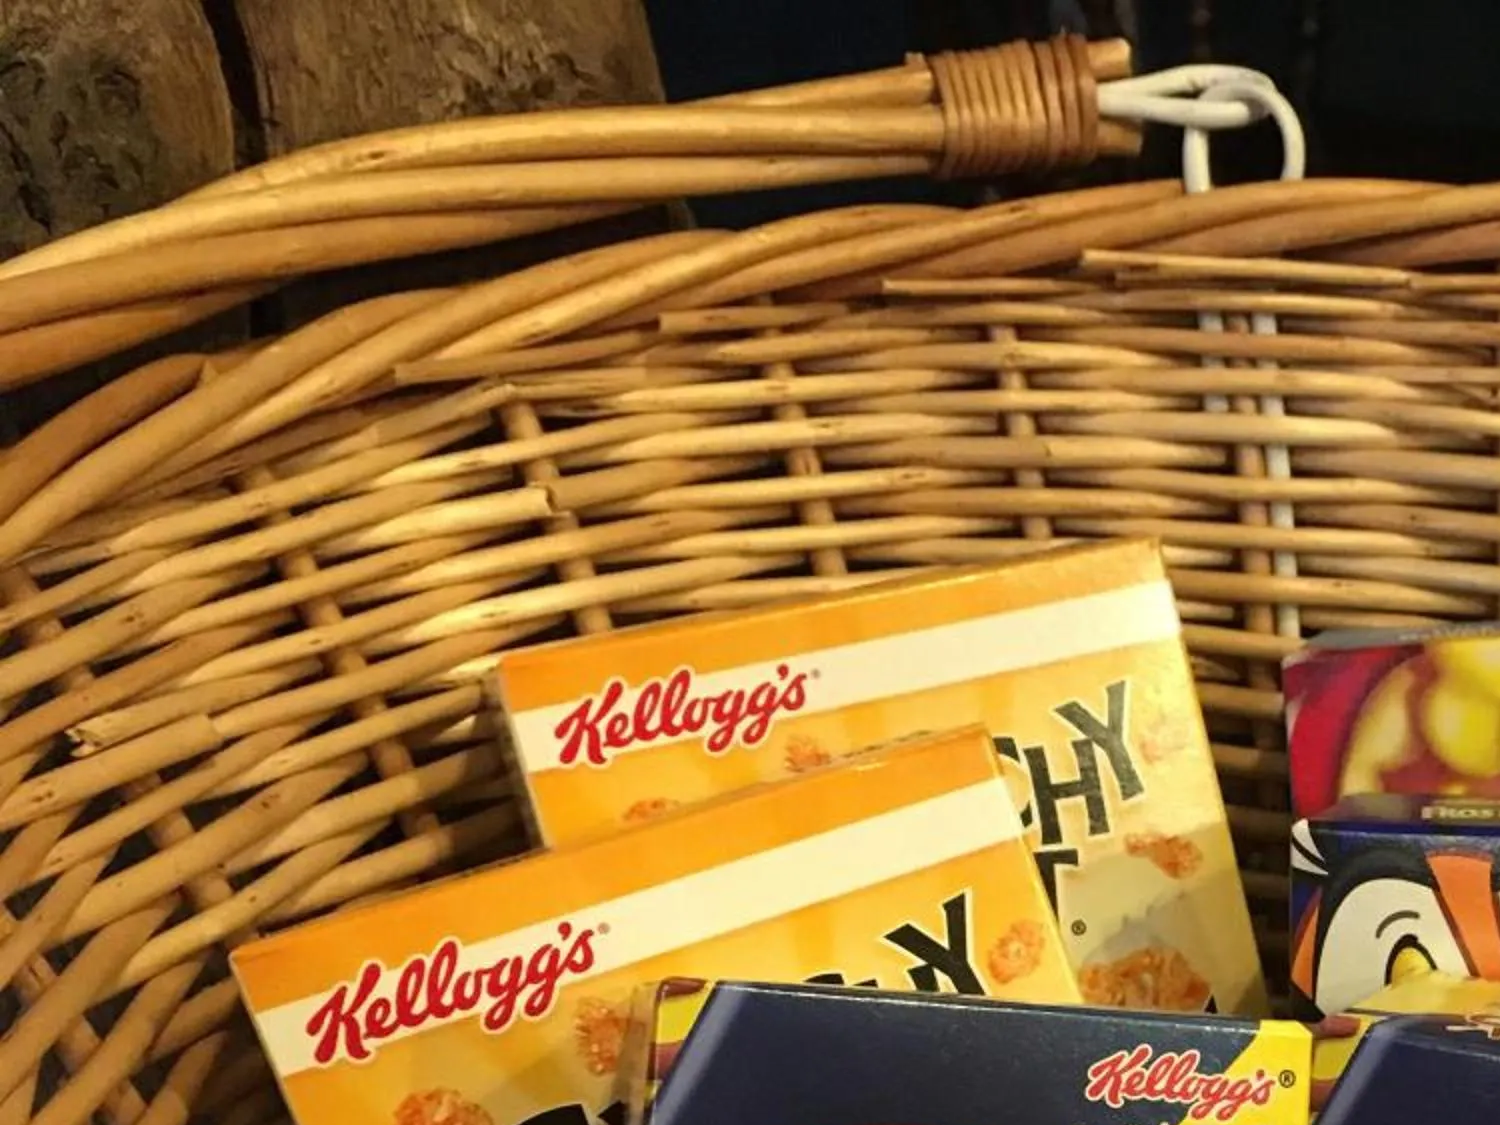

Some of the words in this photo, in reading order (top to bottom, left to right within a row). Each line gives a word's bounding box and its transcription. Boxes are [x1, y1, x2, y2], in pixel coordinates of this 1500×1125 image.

[554, 663, 808, 767] Kellogg's
[305, 920, 598, 1064] Kellogg's
[1087, 1044, 1276, 1121] Kellogg's
